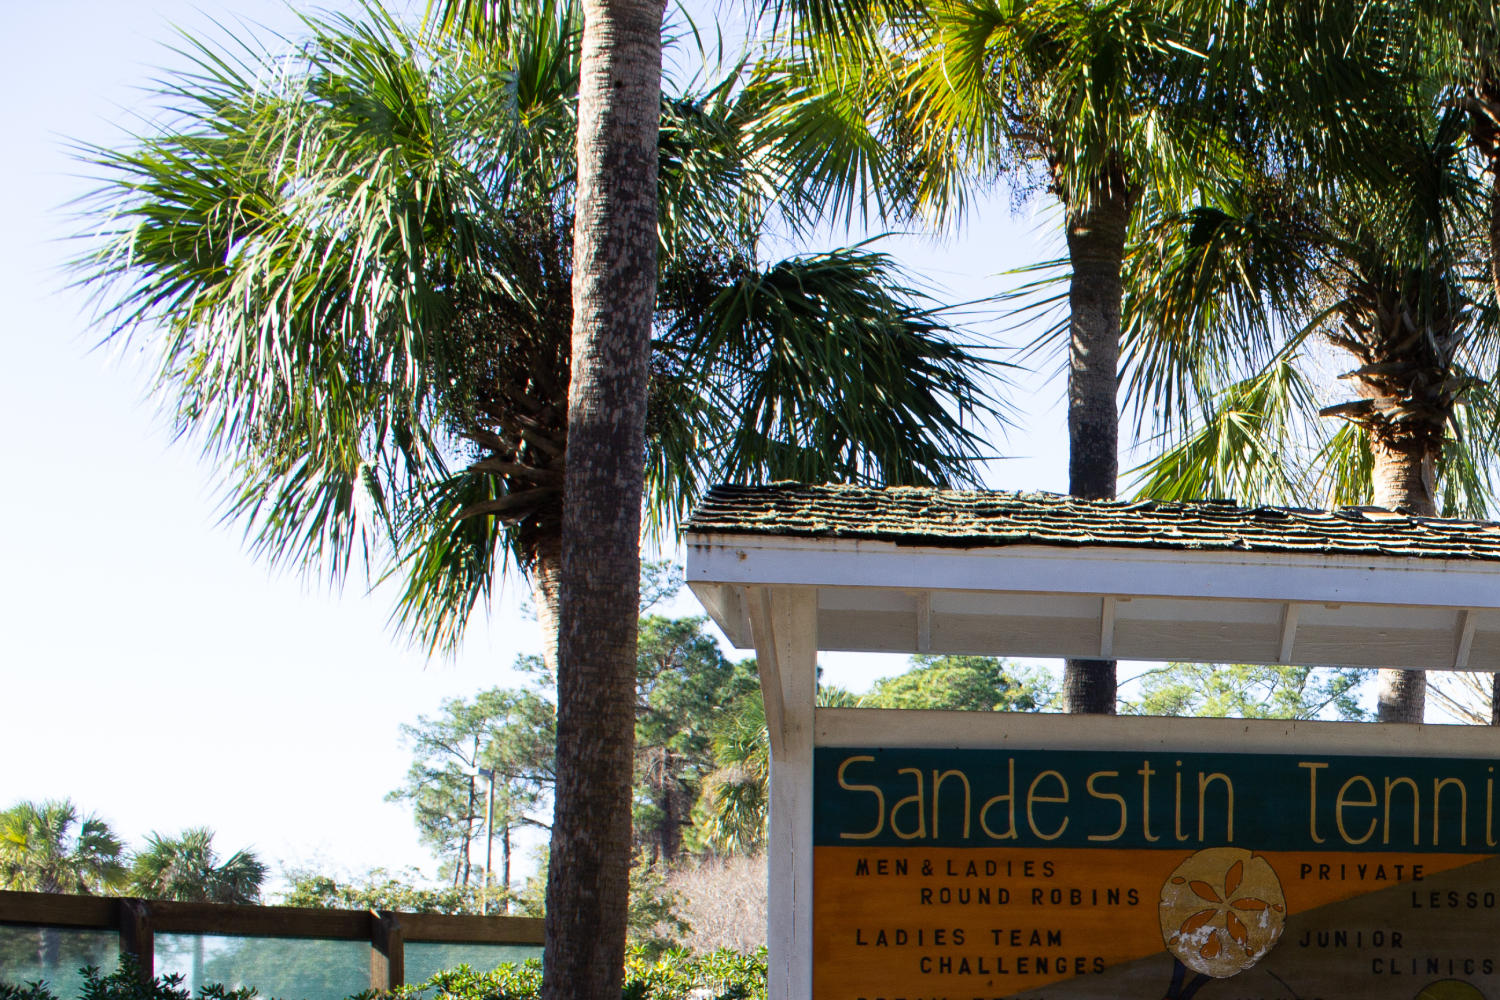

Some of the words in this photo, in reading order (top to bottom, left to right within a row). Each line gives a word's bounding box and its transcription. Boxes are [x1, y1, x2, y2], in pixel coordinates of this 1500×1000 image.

[838, 757, 1235, 840] Sandestin
[855, 859, 910, 877] MEN
[946, 860, 1056, 878] LADIES
[1299, 864, 1425, 882] PRIVATE
[920, 887, 1011, 906] ROUND
[1032, 887, 1141, 906] ROBINS
[856, 928, 967, 947] LADIES
[991, 929, 1063, 947] TEAM
[1299, 930, 1405, 949] JUNIOR
[920, 956, 1106, 975] CHALLENGES
[1372, 957, 1495, 976] CLINICS
